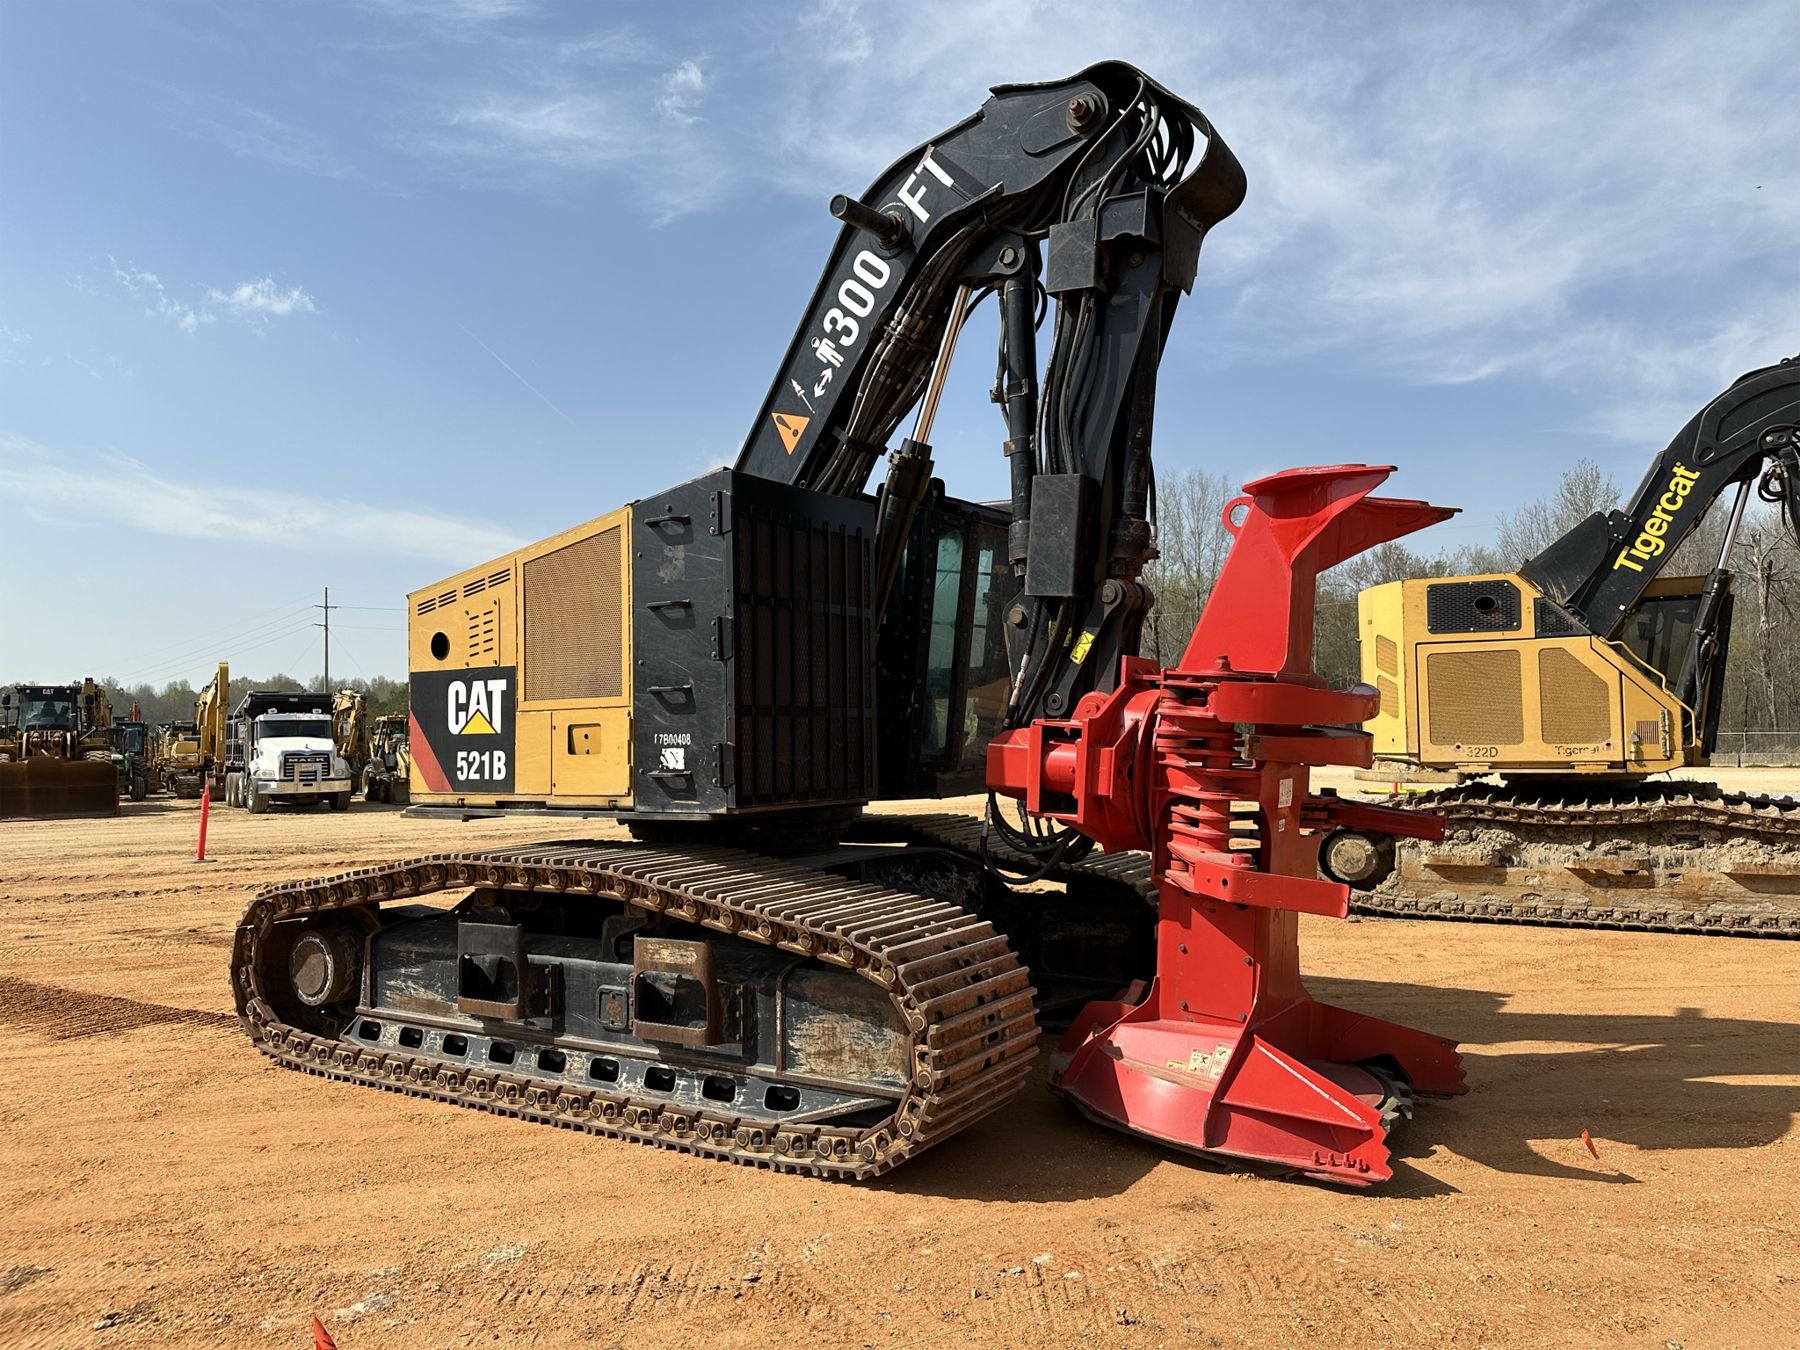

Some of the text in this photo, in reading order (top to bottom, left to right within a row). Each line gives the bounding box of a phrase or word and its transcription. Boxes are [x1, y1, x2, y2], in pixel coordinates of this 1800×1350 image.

[823, 144, 954, 347] 300 FT
[1613, 461, 1701, 572] Tigercat
[447, 679, 507, 735] CAT
[456, 750, 507, 781] 521B
